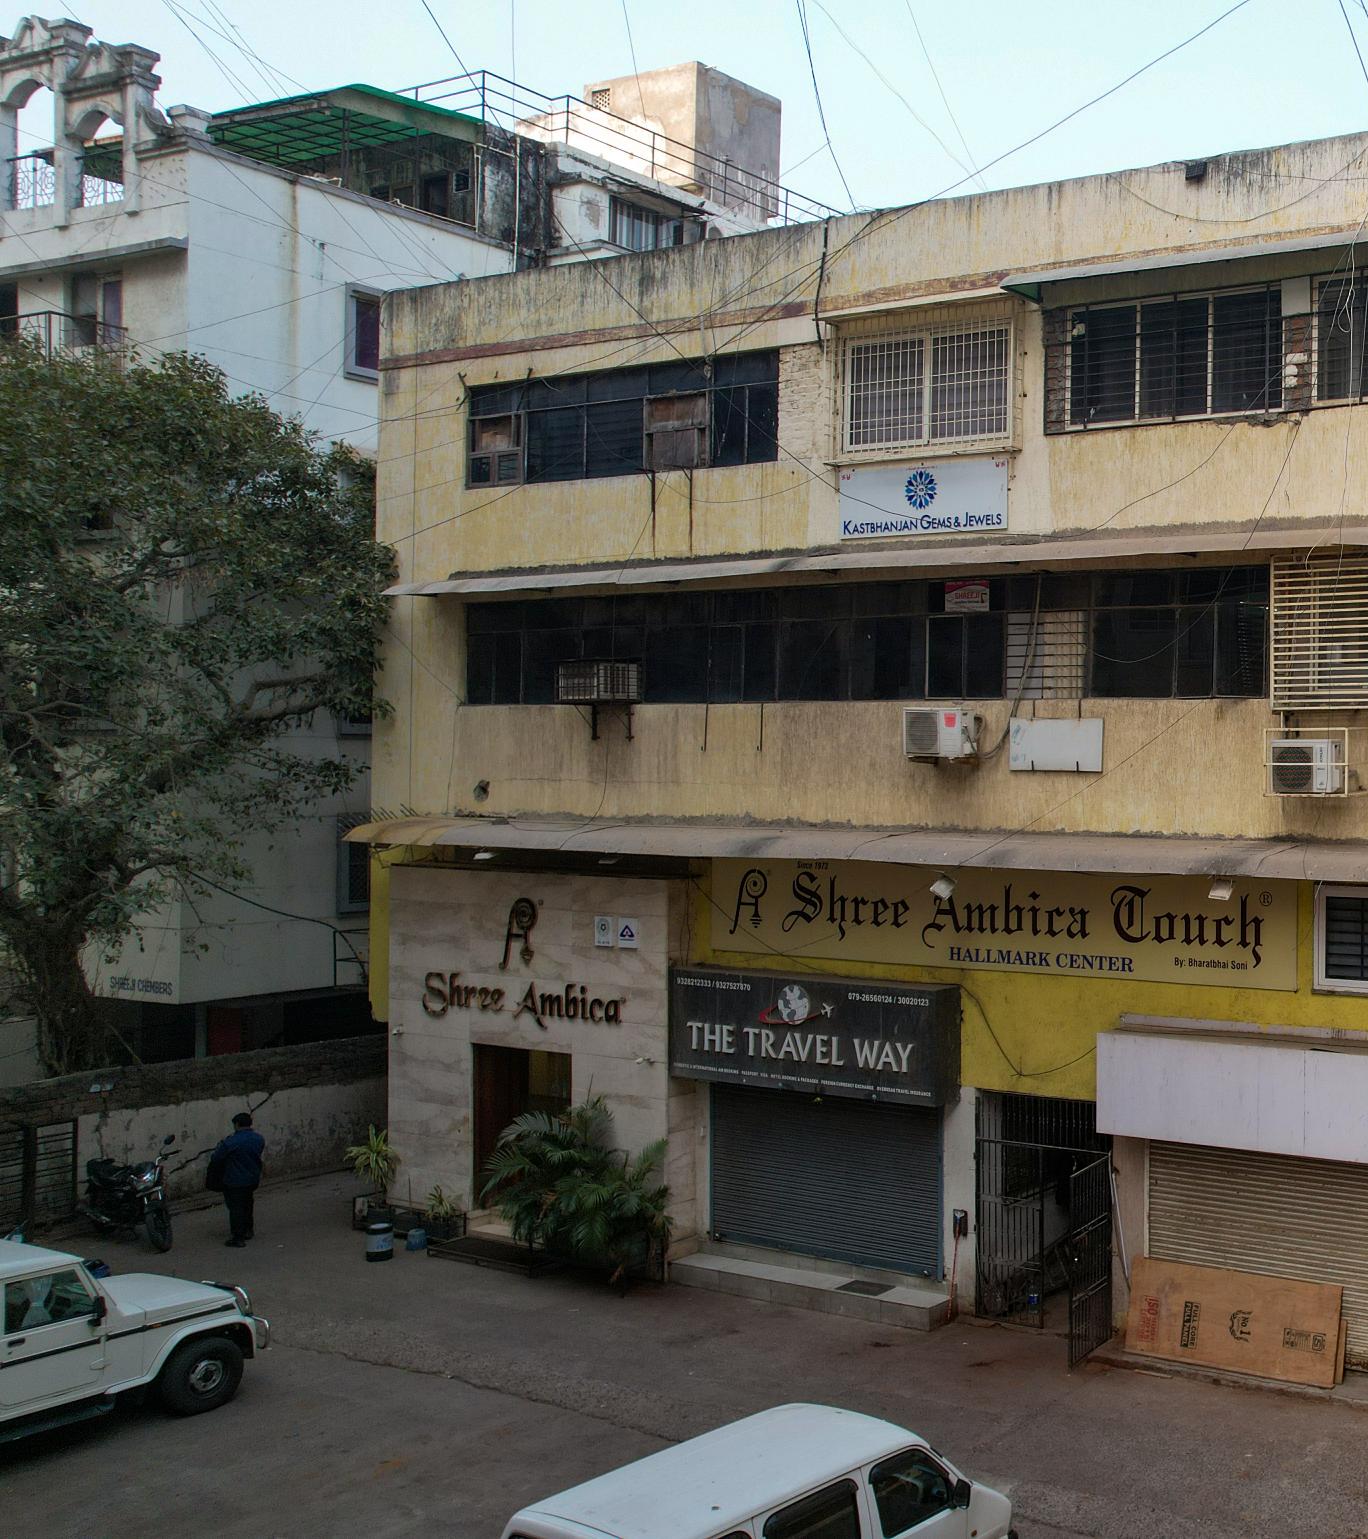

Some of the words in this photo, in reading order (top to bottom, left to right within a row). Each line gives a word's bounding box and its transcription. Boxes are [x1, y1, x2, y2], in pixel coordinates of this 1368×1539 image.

[843, 519, 918, 535] KASTBHANJAN
[920, 514, 952, 530] GEMS
[953, 516, 961, 528] &
[963, 511, 1002, 527] JEWELS
[782, 871, 910, 941] Shree
[922, 883, 1090, 948] Ambica
[949, 946, 1050, 967] HALLMARK
[1056, 953, 1134, 973] CENTER
[1188, 957, 1229, 969] Bharatbhai
[1231, 960, 1248, 970] Soni
[423, 971, 506, 1018] Shree
[513, 981, 623, 1030] Ambica
[686, 1021, 738, 1055] THE
[743, 1026, 845, 1068] TRAVEL
[853, 1038, 915, 1074] WAY
